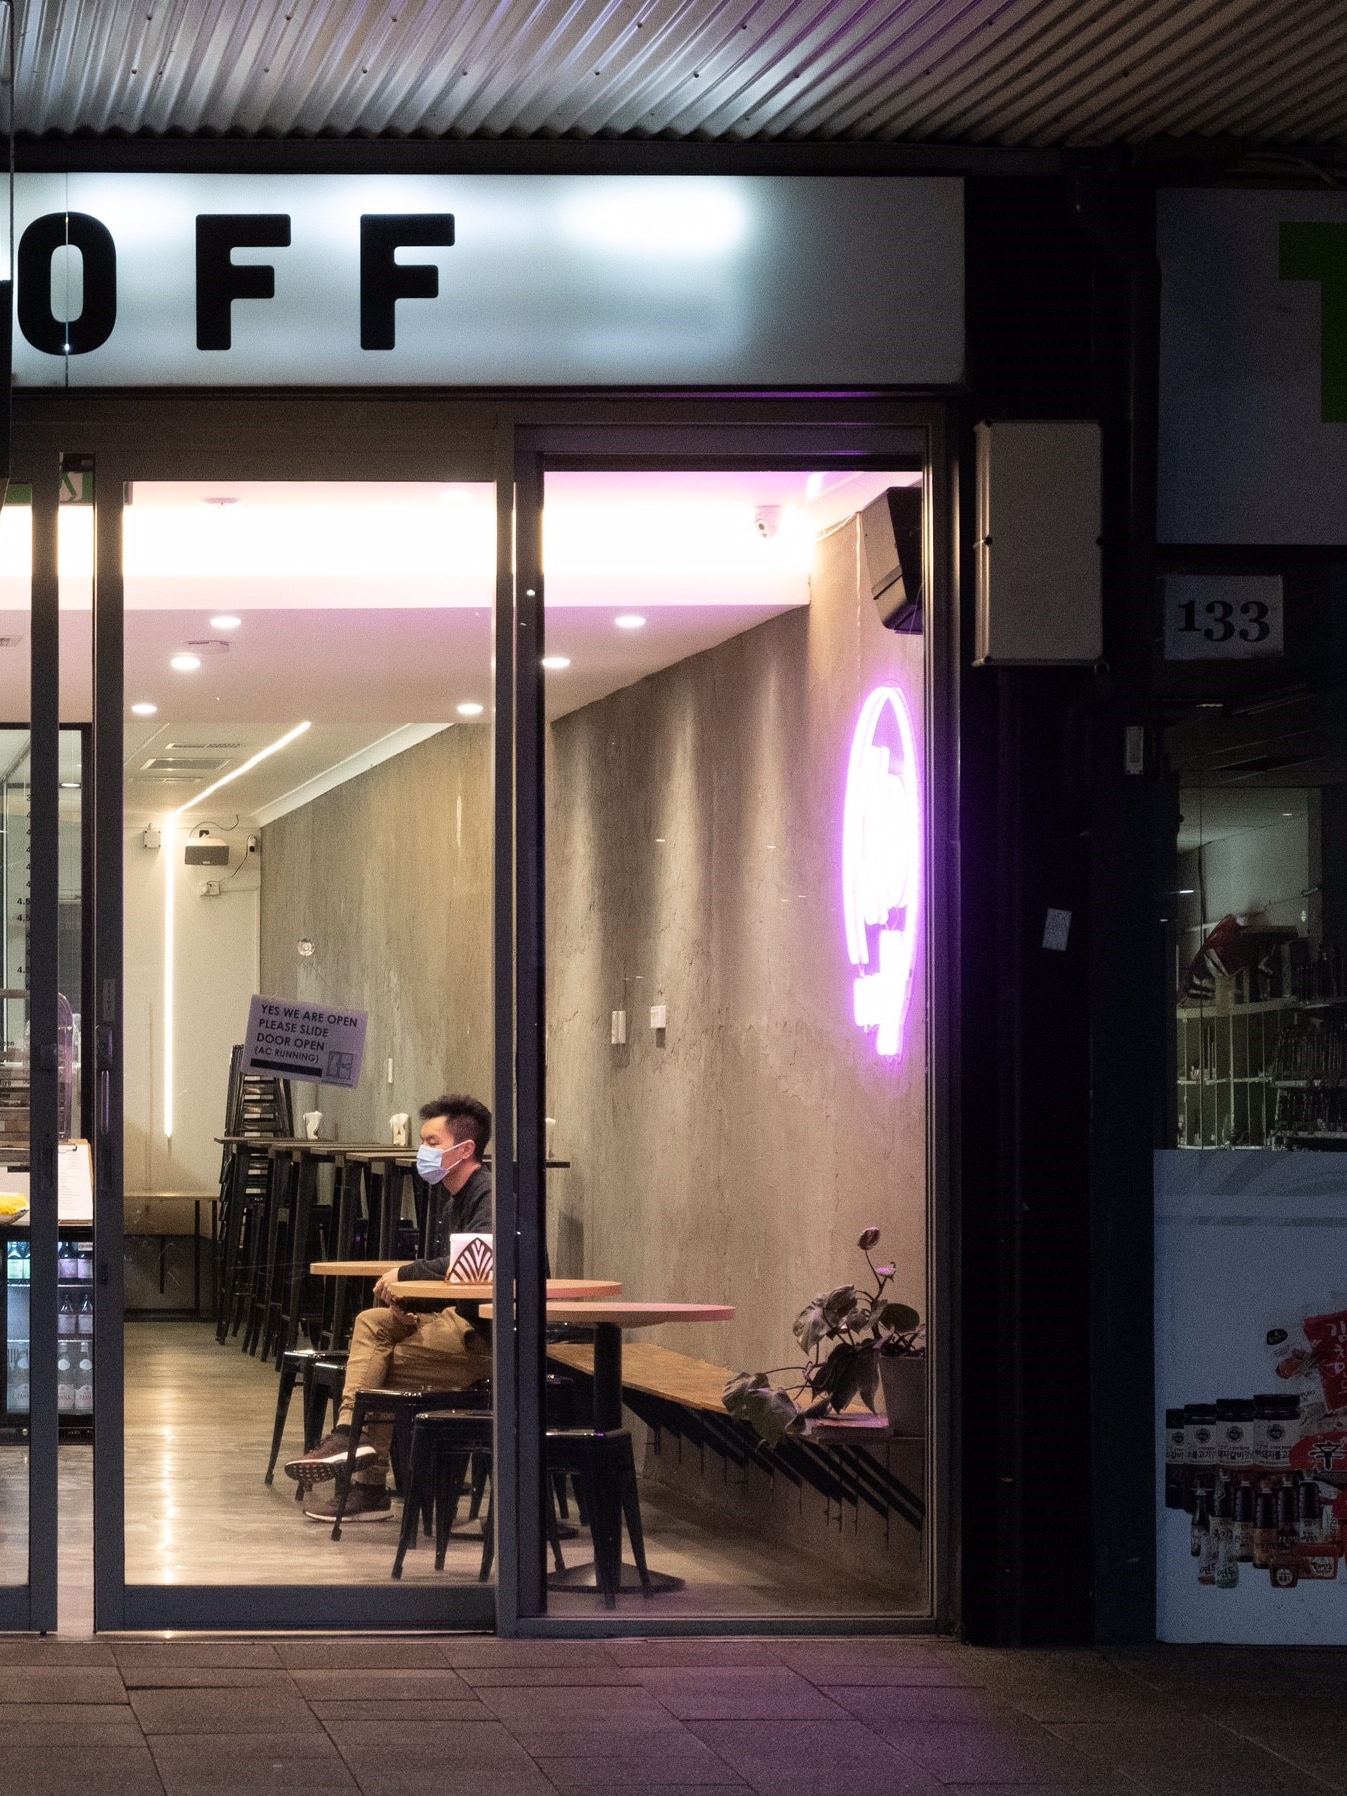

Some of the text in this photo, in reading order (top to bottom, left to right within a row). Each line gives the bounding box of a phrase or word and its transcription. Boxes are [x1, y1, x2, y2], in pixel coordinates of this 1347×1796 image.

[1176, 599, 1271, 643] 133
[261, 1004, 358, 1028] YES WE ARE OPEN
[258, 1018, 329, 1038] PLEASE SLIDE
[256, 1032, 325, 1051] DOOR OPEN
[254, 1045, 320, 1064] (AC RUNNING)
